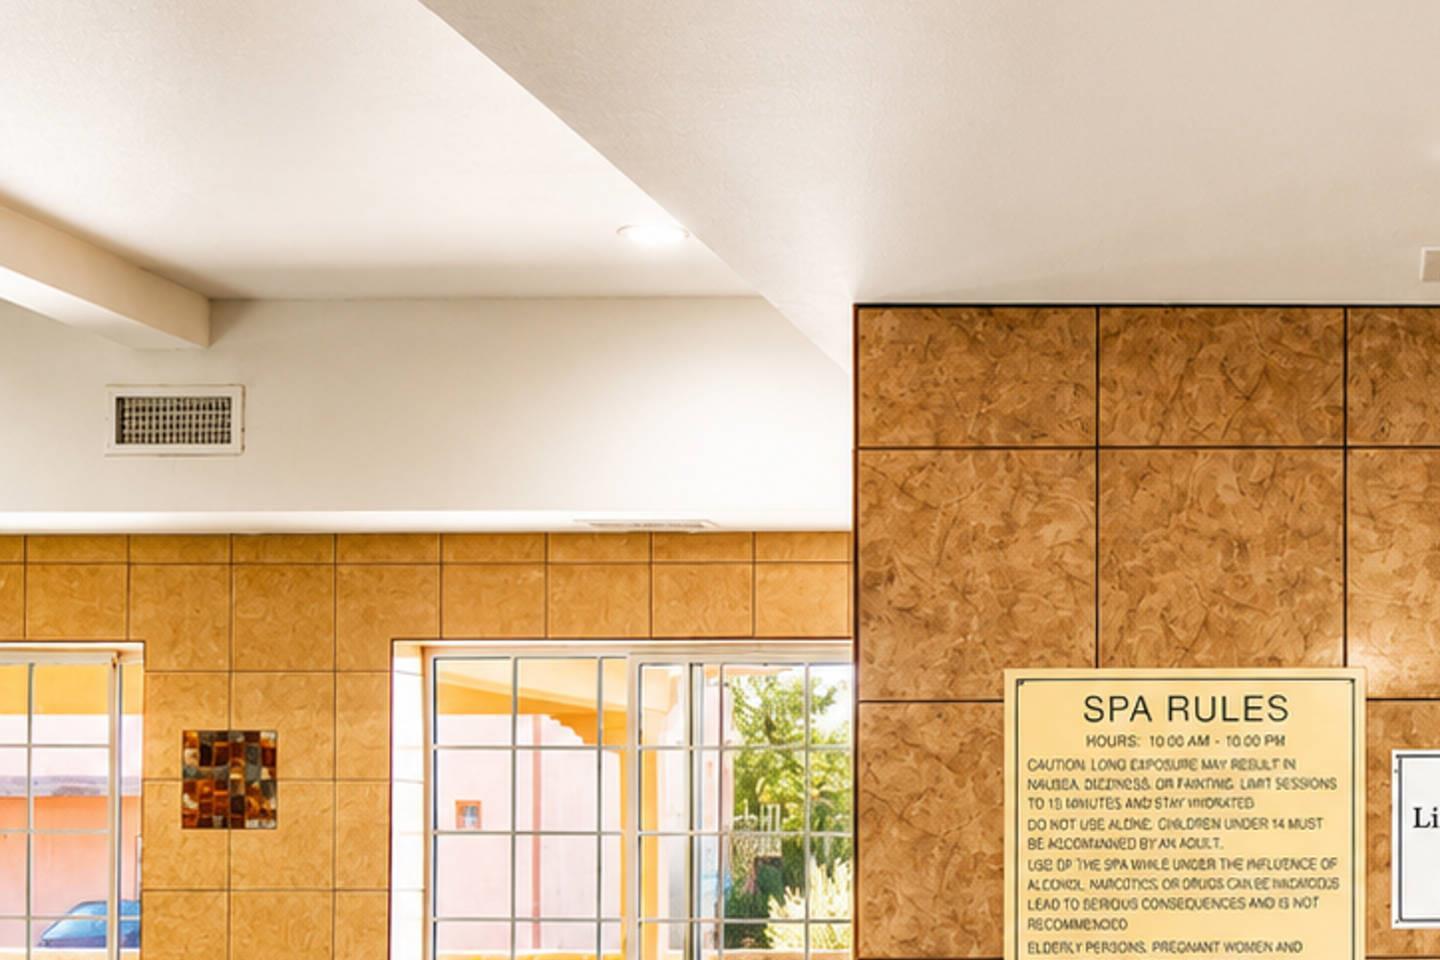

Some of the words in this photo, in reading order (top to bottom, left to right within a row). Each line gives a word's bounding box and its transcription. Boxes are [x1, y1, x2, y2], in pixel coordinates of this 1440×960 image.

[1083, 695, 1152, 722] SPA
[1168, 695, 1289, 722] RULES
[1187, 735, 1210, 747] AM
[1264, 734, 1285, 746] PM
